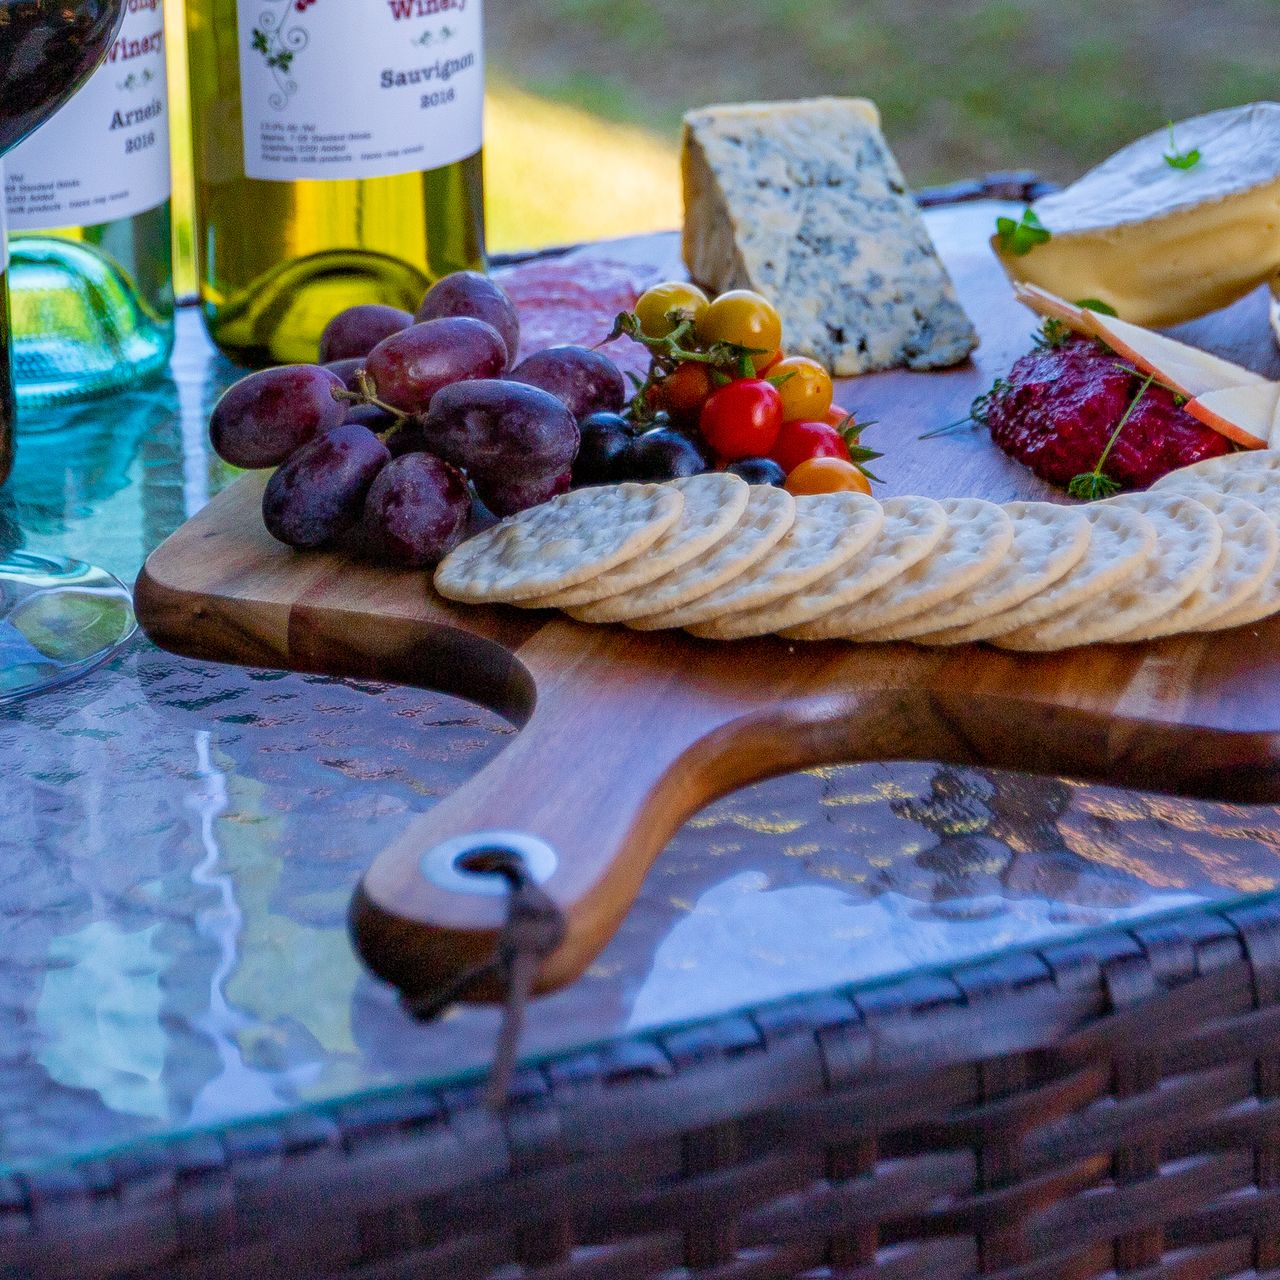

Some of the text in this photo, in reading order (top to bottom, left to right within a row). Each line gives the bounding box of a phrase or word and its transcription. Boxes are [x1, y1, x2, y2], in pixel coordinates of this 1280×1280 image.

[380, 52, 474, 89] Sauvignon
[420, 87, 455, 108] 2016
[109, 98, 163, 131] Arneis
[125, 132, 155, 154] 2016
